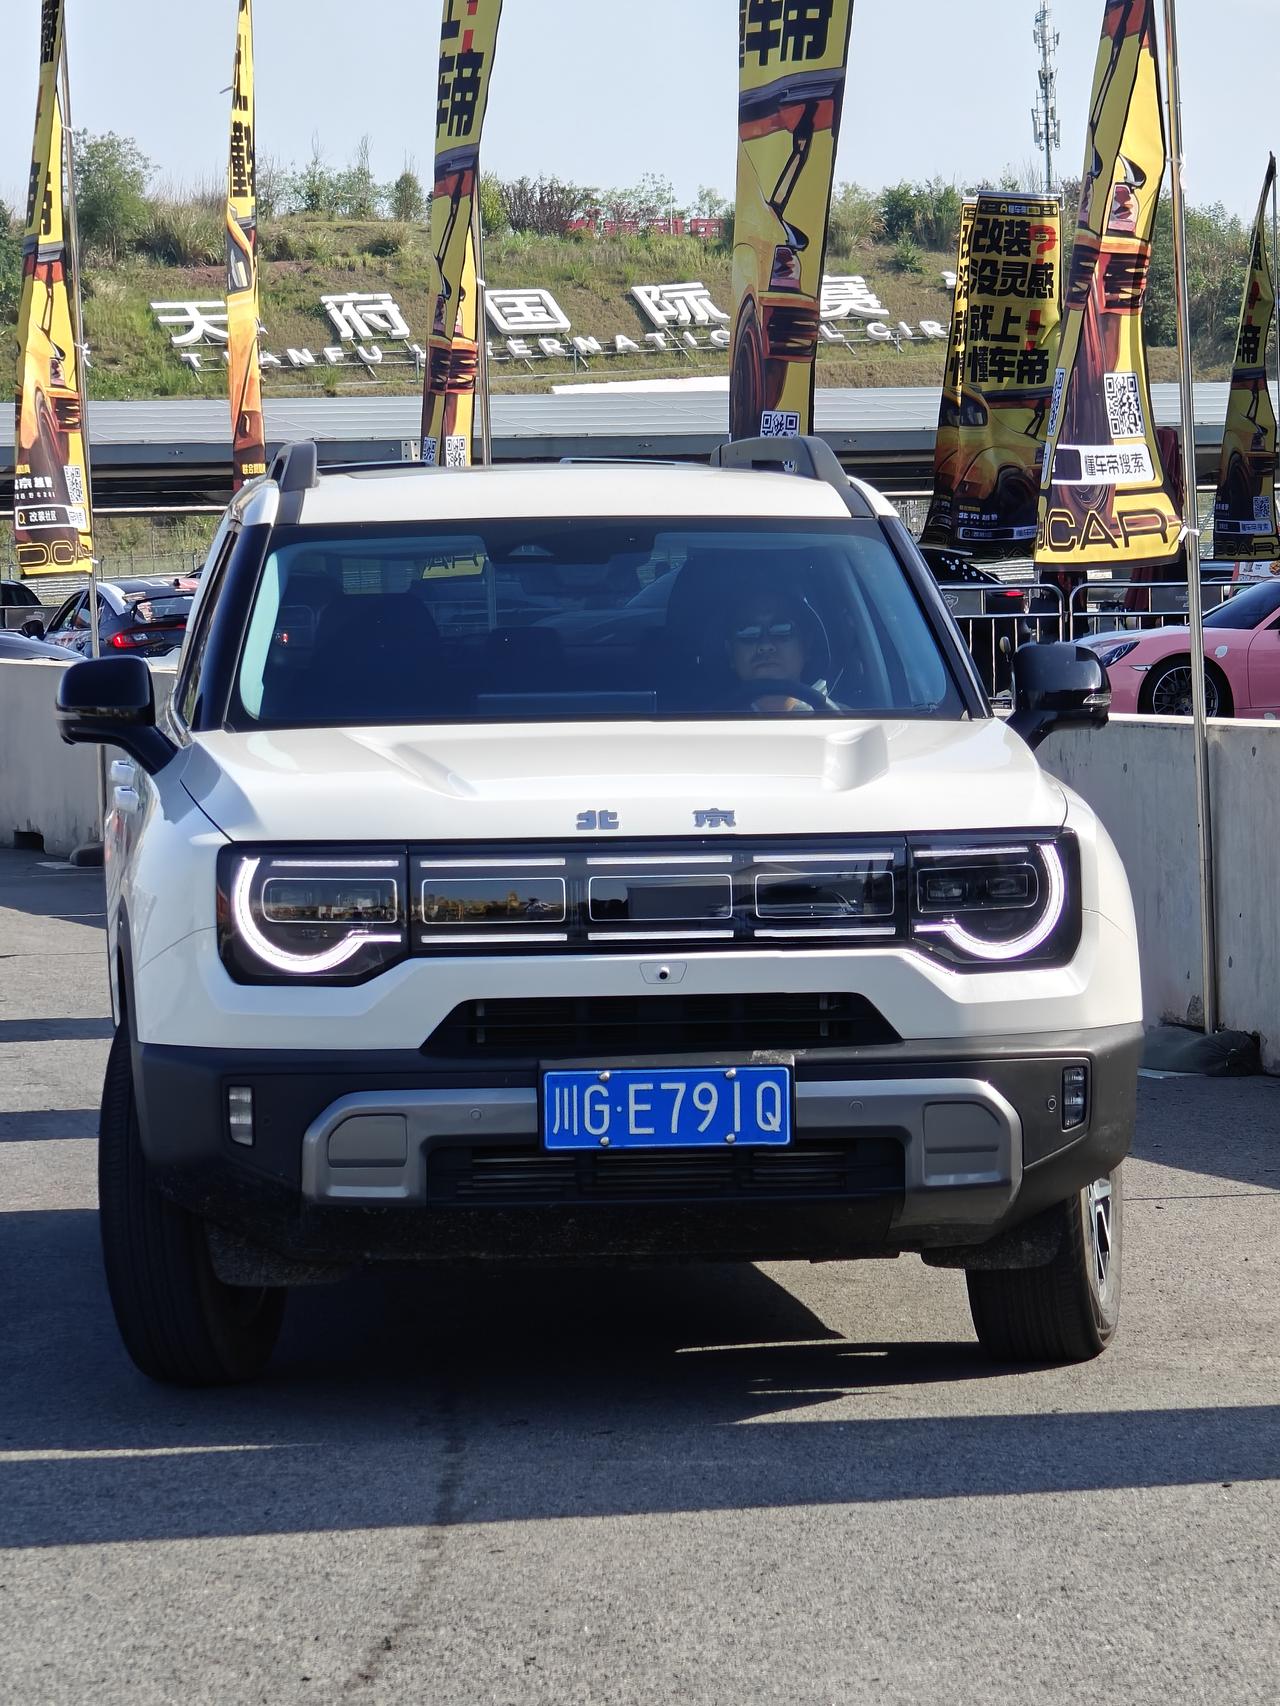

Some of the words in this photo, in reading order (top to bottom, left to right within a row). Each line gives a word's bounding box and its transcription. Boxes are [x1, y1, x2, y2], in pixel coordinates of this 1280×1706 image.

[740, 0, 834, 67] 车帝
[970, 258, 1055, 299] 没灵感
[866, 320, 952, 341] CIR
[966, 345, 1049, 385] 懂车帝
[1038, 507, 1169, 552] CAR
[576, 807, 736, 831] 北京
